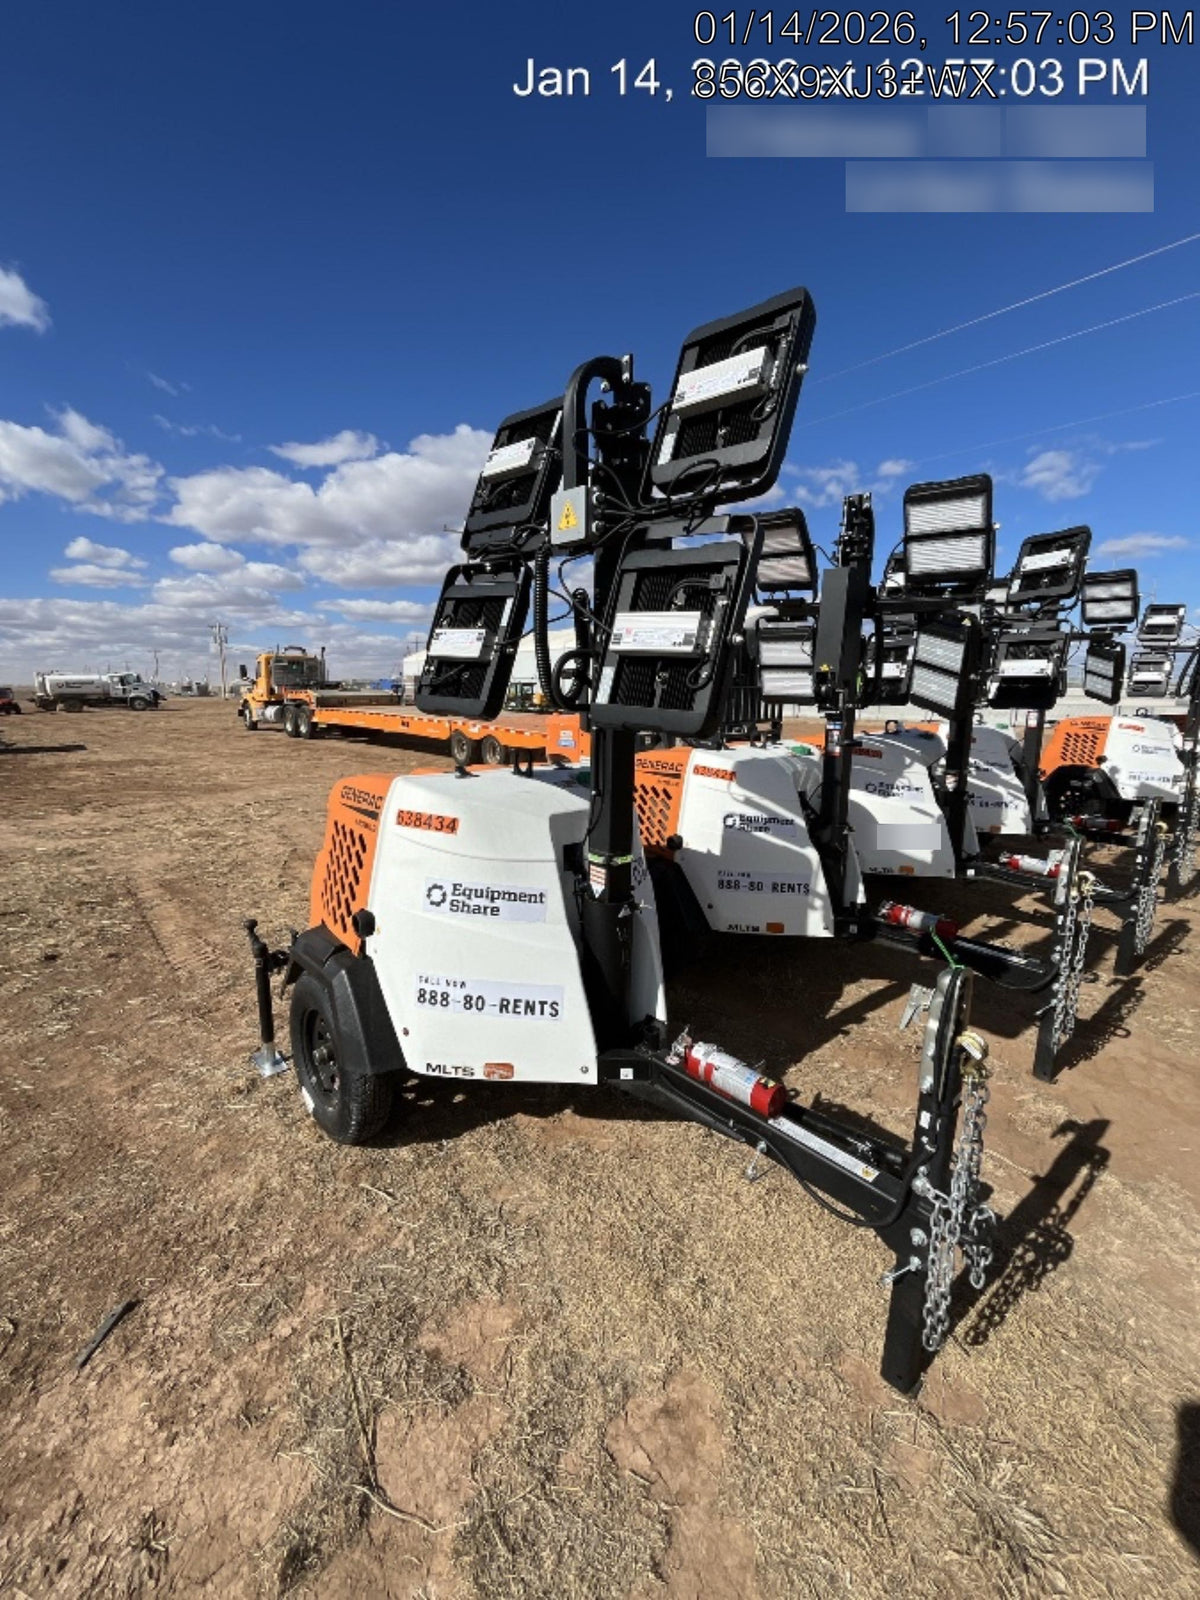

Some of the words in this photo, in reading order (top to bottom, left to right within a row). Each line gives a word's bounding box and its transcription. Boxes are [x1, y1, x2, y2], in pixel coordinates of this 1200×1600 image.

[341, 785, 384, 809] GENERAC
[397, 810, 459, 834] 638434
[450, 882, 546, 904] Equipment
[449, 899, 500, 917] Share
[425, 1062, 476, 1078] MLTS
